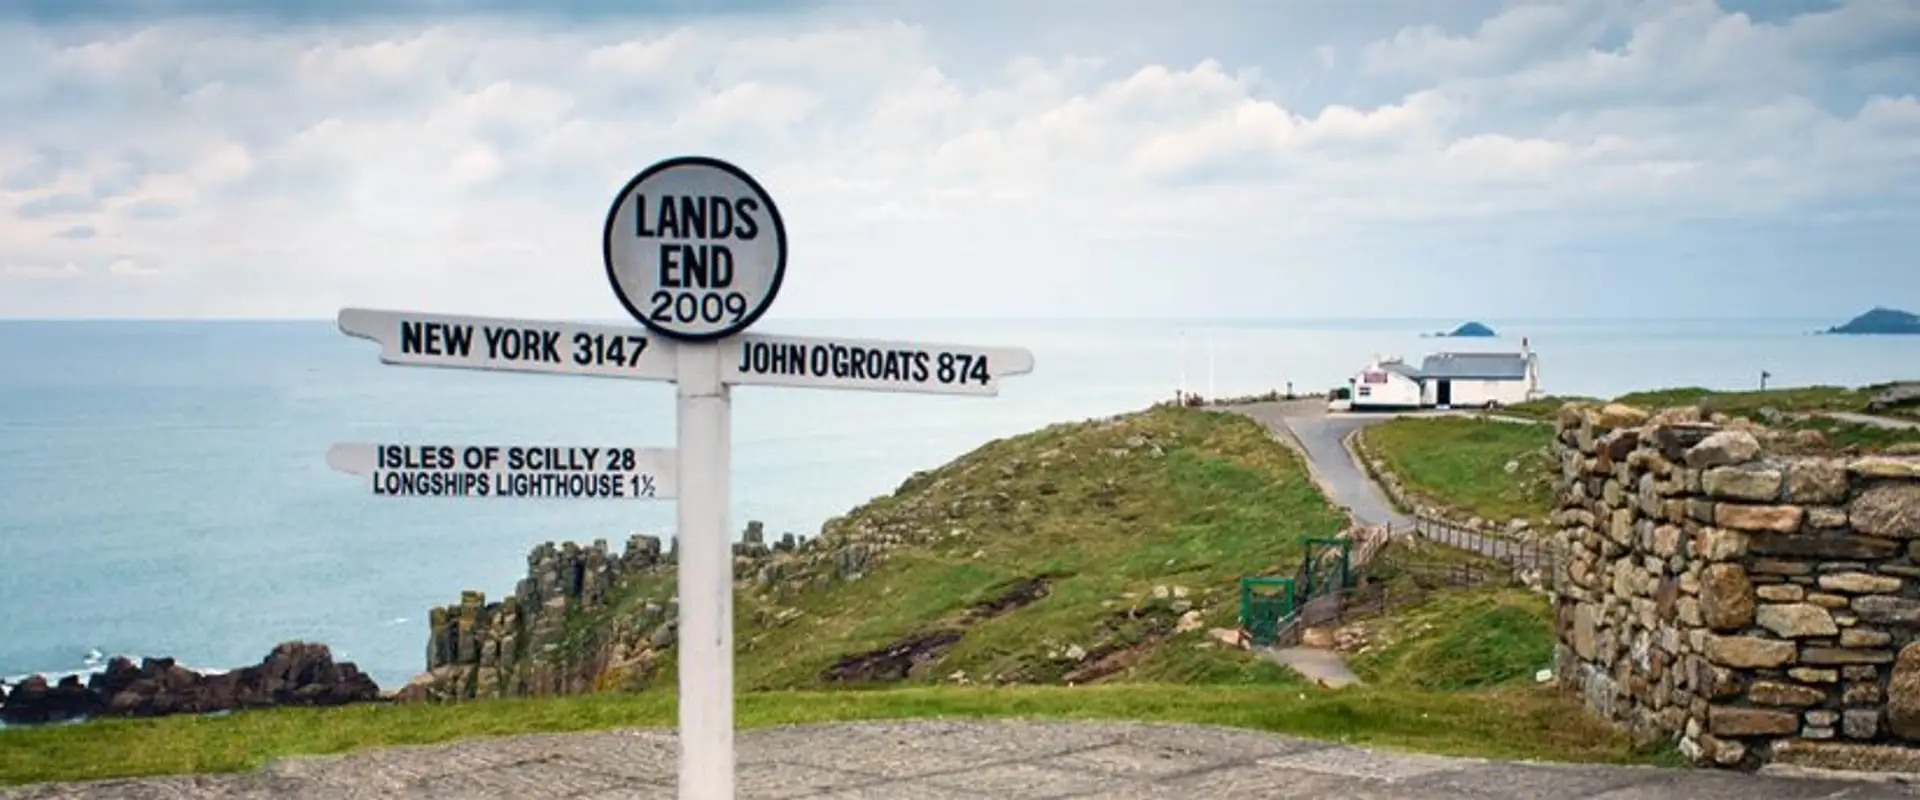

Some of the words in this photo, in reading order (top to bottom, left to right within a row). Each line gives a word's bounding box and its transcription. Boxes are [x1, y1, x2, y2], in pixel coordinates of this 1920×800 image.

[635, 193, 760, 241] LANDS
[659, 243, 734, 290] END
[650, 290, 748, 325] 2009
[400, 319, 475, 359] NEW
[482, 325, 562, 365] YORK
[572, 331, 650, 369] 3147
[737, 340, 808, 377] JOHN
[809, 343, 931, 384] O'GROATS
[935, 351, 992, 387] 874
[377, 445, 456, 470] ISLES
[462, 446, 501, 470] OF
[506, 446, 601, 471] SCILLY
[605, 447, 637, 471] 28
[372, 470, 492, 497] LONGSHIPS
[495, 473, 625, 498] LIGHTHOUSE
